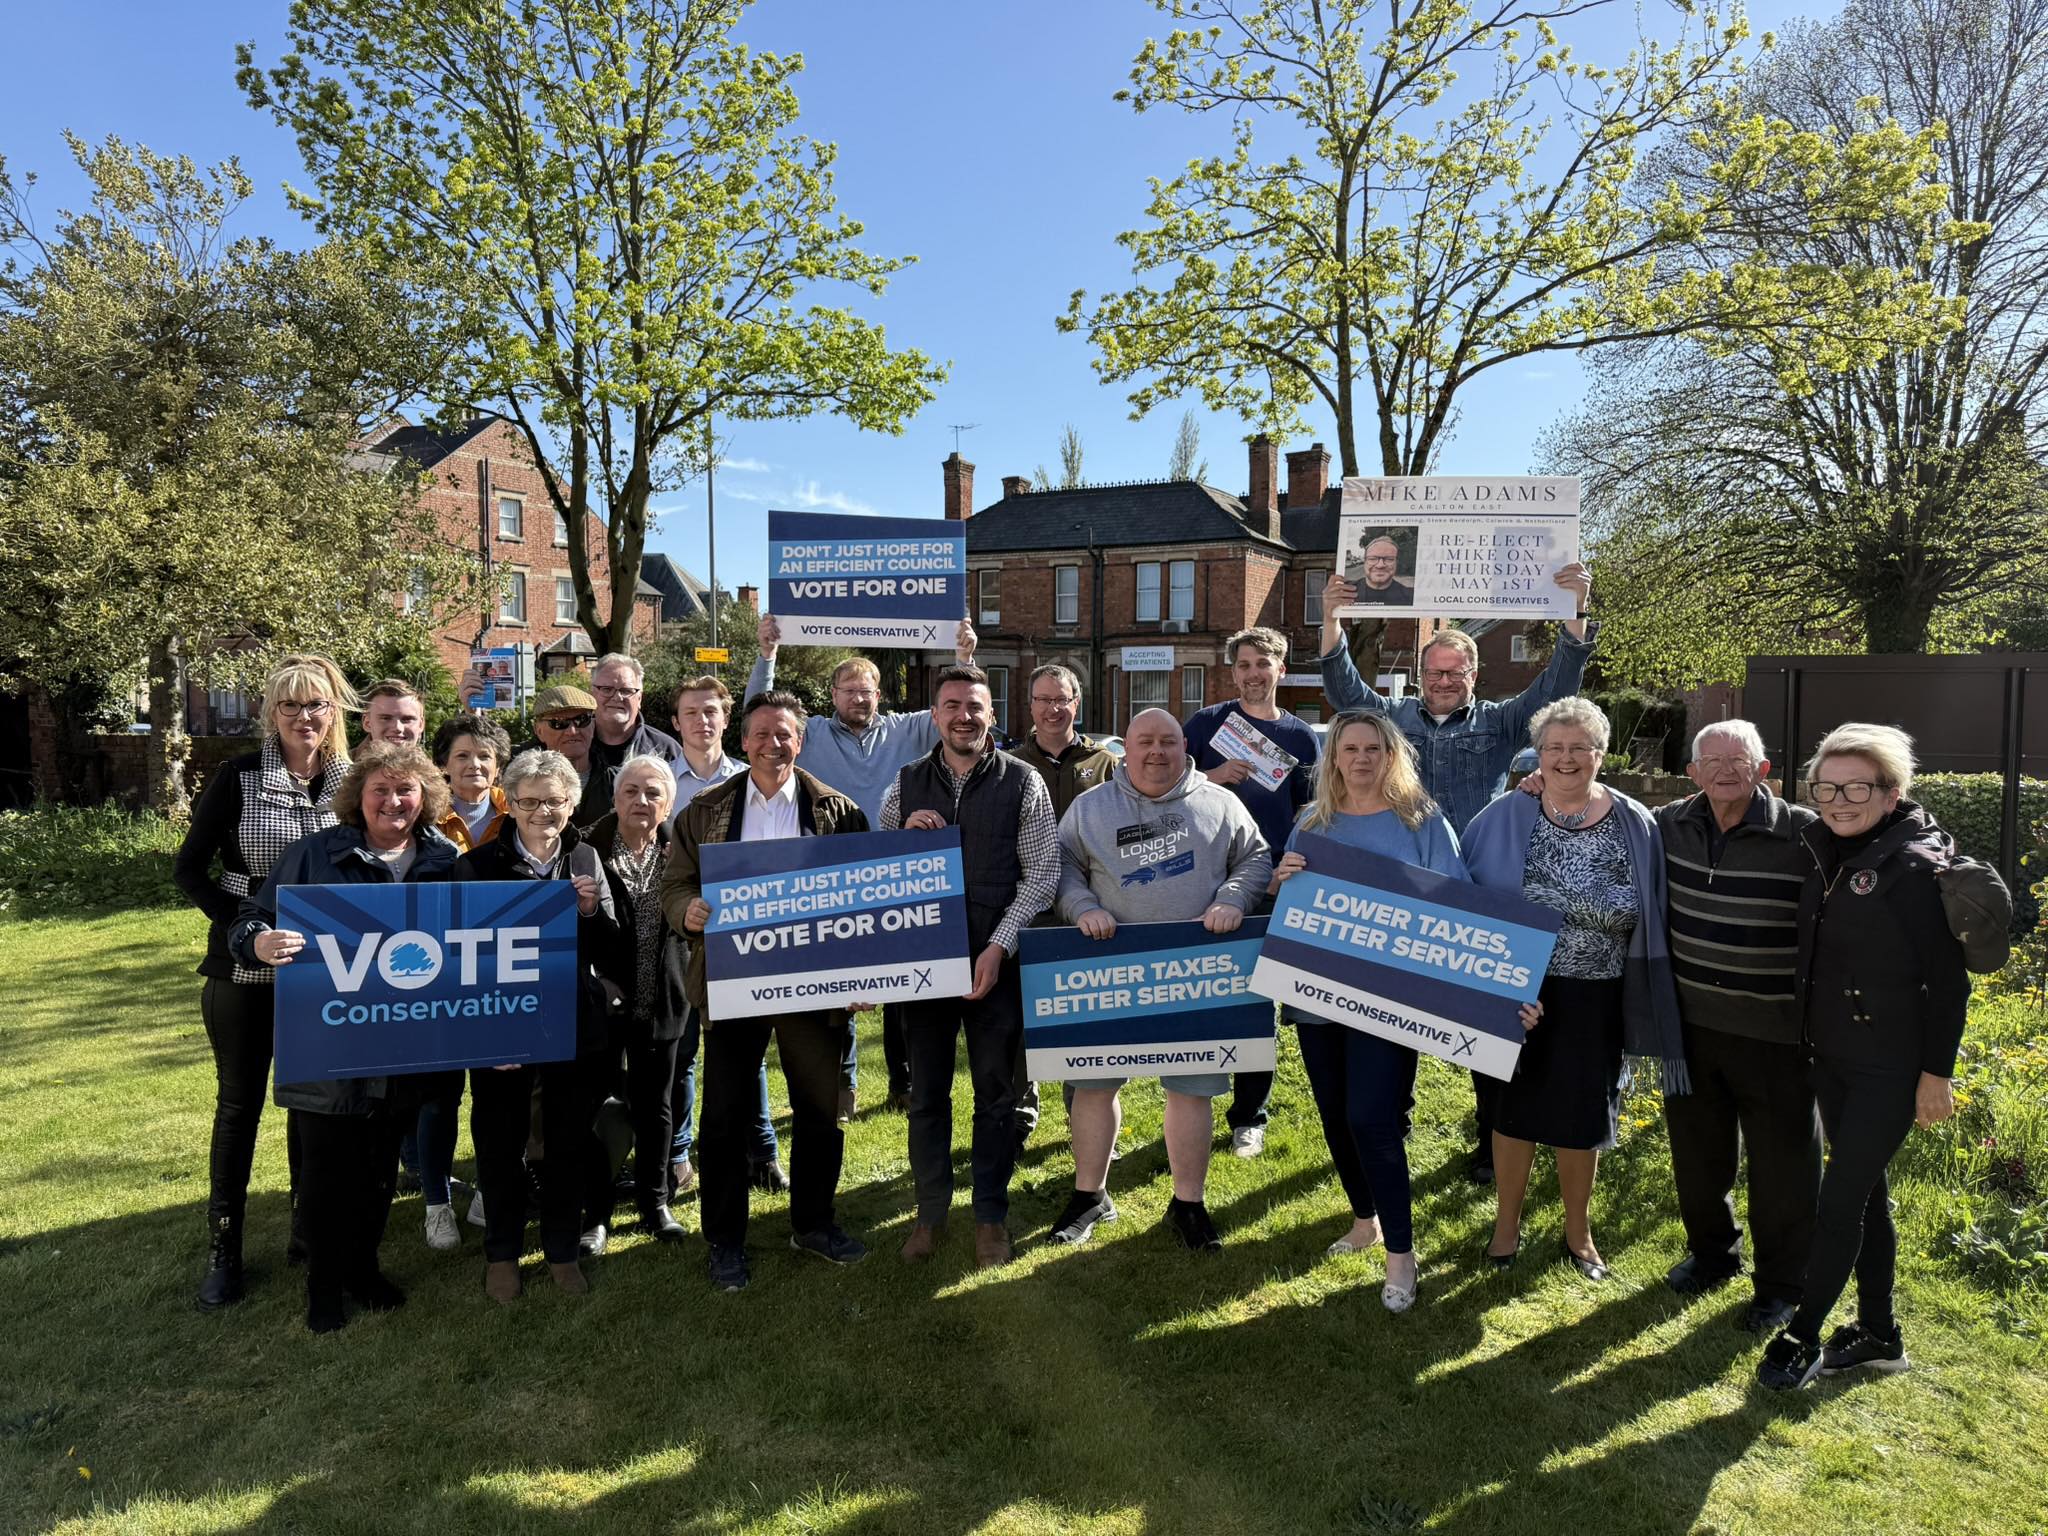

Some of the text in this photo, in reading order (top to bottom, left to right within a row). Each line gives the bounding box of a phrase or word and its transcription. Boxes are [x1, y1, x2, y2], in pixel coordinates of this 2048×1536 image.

[1364, 485, 1558, 501] MIKE ADAMS
[782, 543, 953, 558] DON'T JUST HOPE FOR
[1441, 534, 1544, 547] RE-ELECT
[779, 557, 956, 574] AN EFFICIENT COUNCIL
[1447, 549, 1535, 561] MIKE ON
[1436, 563, 1545, 575] THURSDAY
[789, 578, 946, 599] VOTE FOR ONE
[1451, 578, 1535, 590] MAY 1ST
[1467, 596, 1550, 604] CONSERVATIVES
[801, 625, 920, 637] VOTE CONSERVATIVE
[1120, 827, 1188, 858] LONDON
[1140, 845, 1176, 865] 2023
[720, 856, 946, 904] DON'T JUST HOPE FOR
[717, 875, 952, 925] AN EFFICIENT COUNCIL
[731, 903, 941, 955] VOTE FOR ONE
[1313, 888, 1512, 960] LOWER TAXES,
[315, 926, 540, 992] VOTE
[1283, 907, 1531, 988] BETTER SERVICES
[1054, 954, 1240, 992] LOWER TAXES,
[751, 974, 910, 1001] VOTE CONSERVATIVE
[321, 990, 539, 1026] Conservative
[1035, 988, 1132, 1017] BETTER
[1293, 980, 1452, 1045] VOTE CONSERVATIVE
[1065, 1050, 1215, 1068] VOTE CONSERVATIVE
